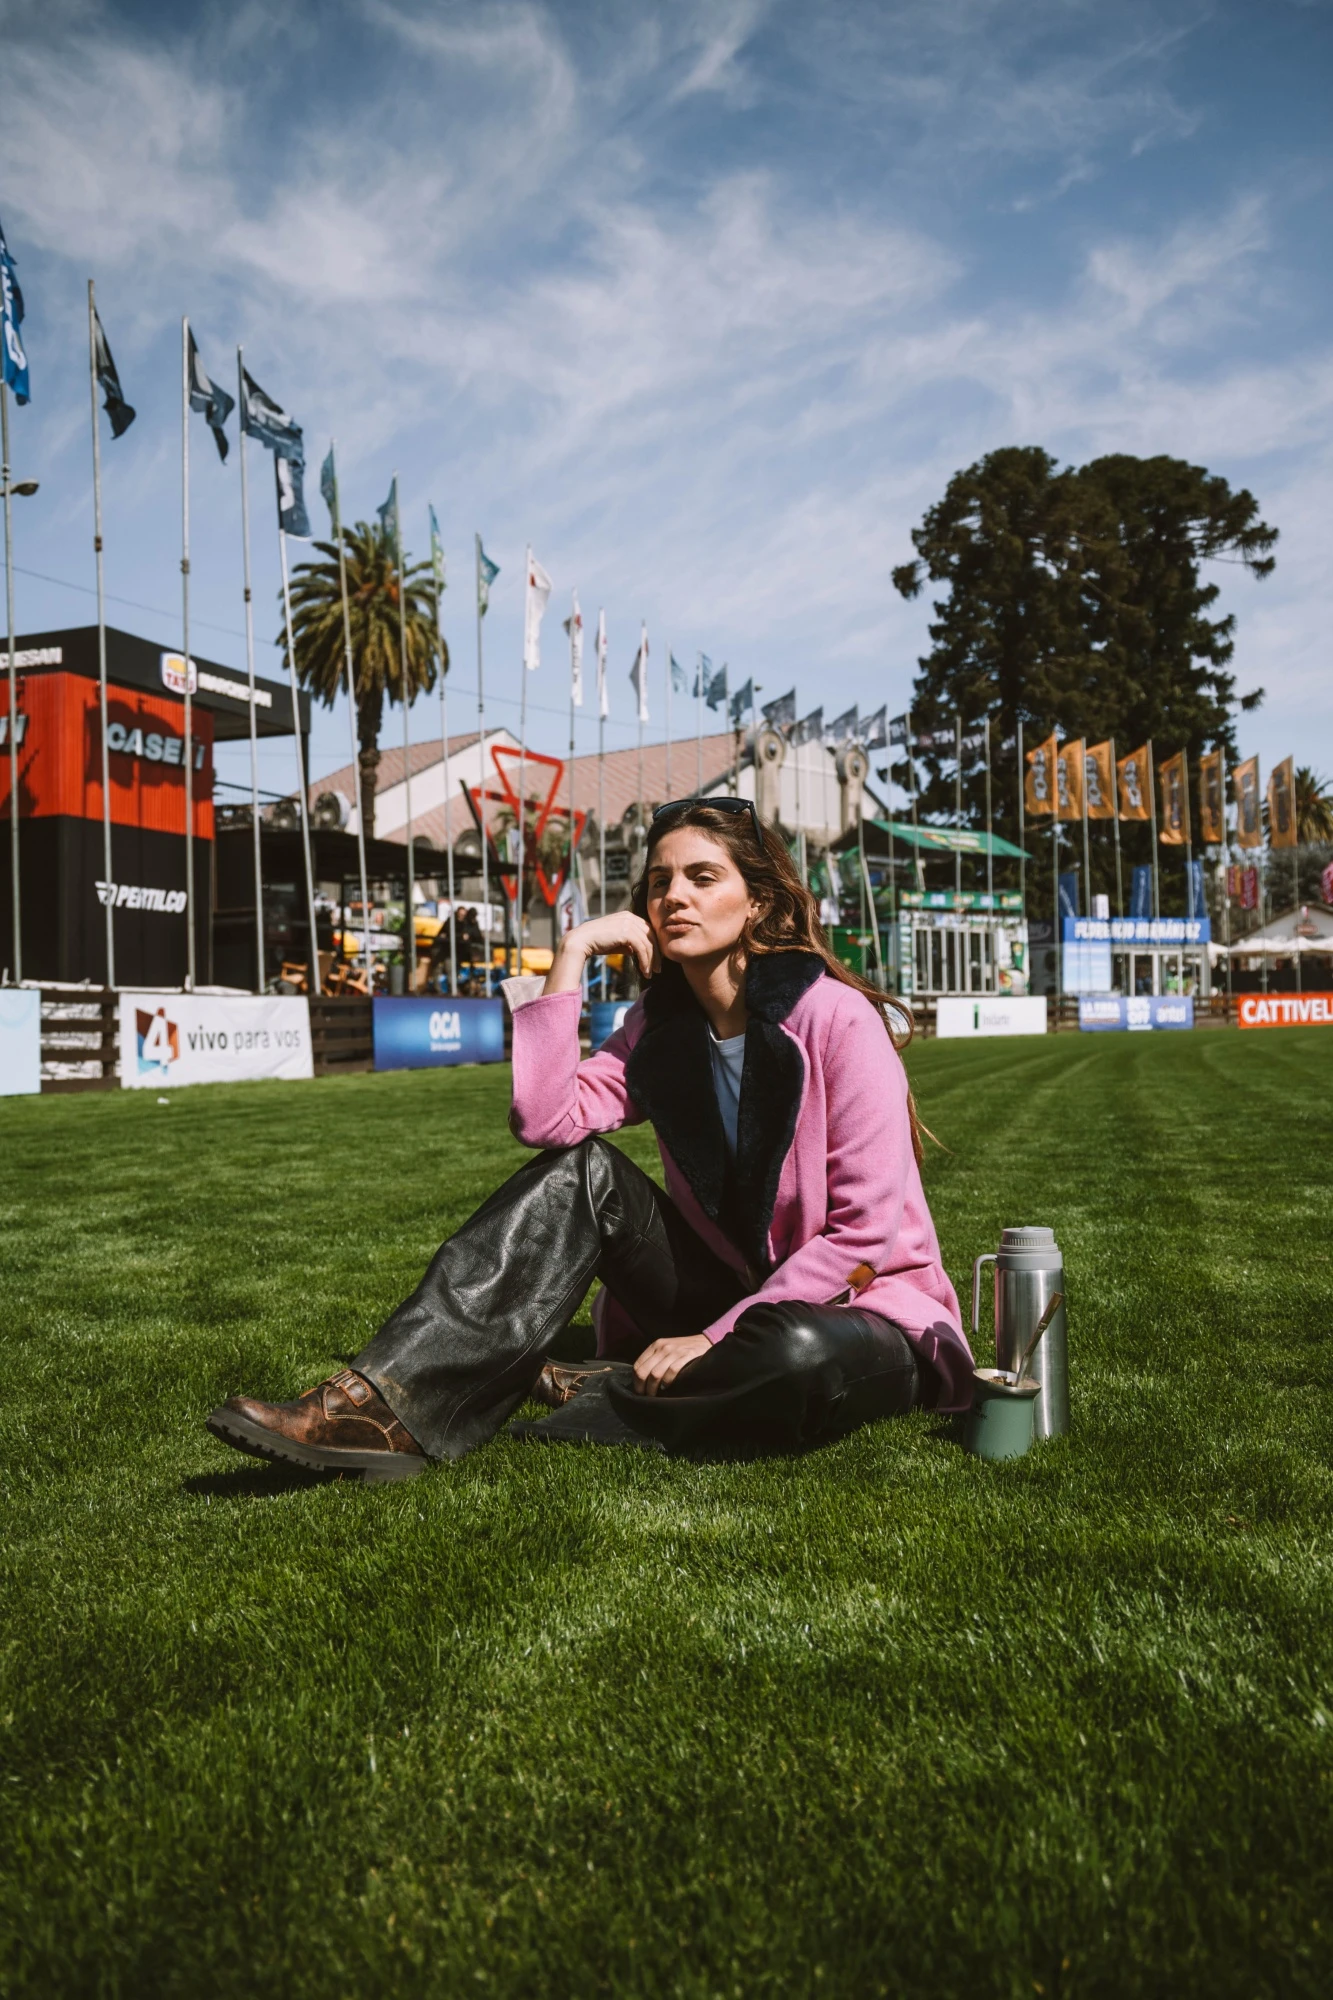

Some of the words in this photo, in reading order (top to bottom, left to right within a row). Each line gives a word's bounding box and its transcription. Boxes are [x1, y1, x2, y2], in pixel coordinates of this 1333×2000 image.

[107, 722, 182, 764] CASE
[429, 1011, 461, 1039] OCA
[1241, 998, 1333, 1024] CATTIVEL
[187, 1025, 228, 1051] vivo
[234, 1030, 270, 1054] para
[274, 1030, 300, 1048] vos
